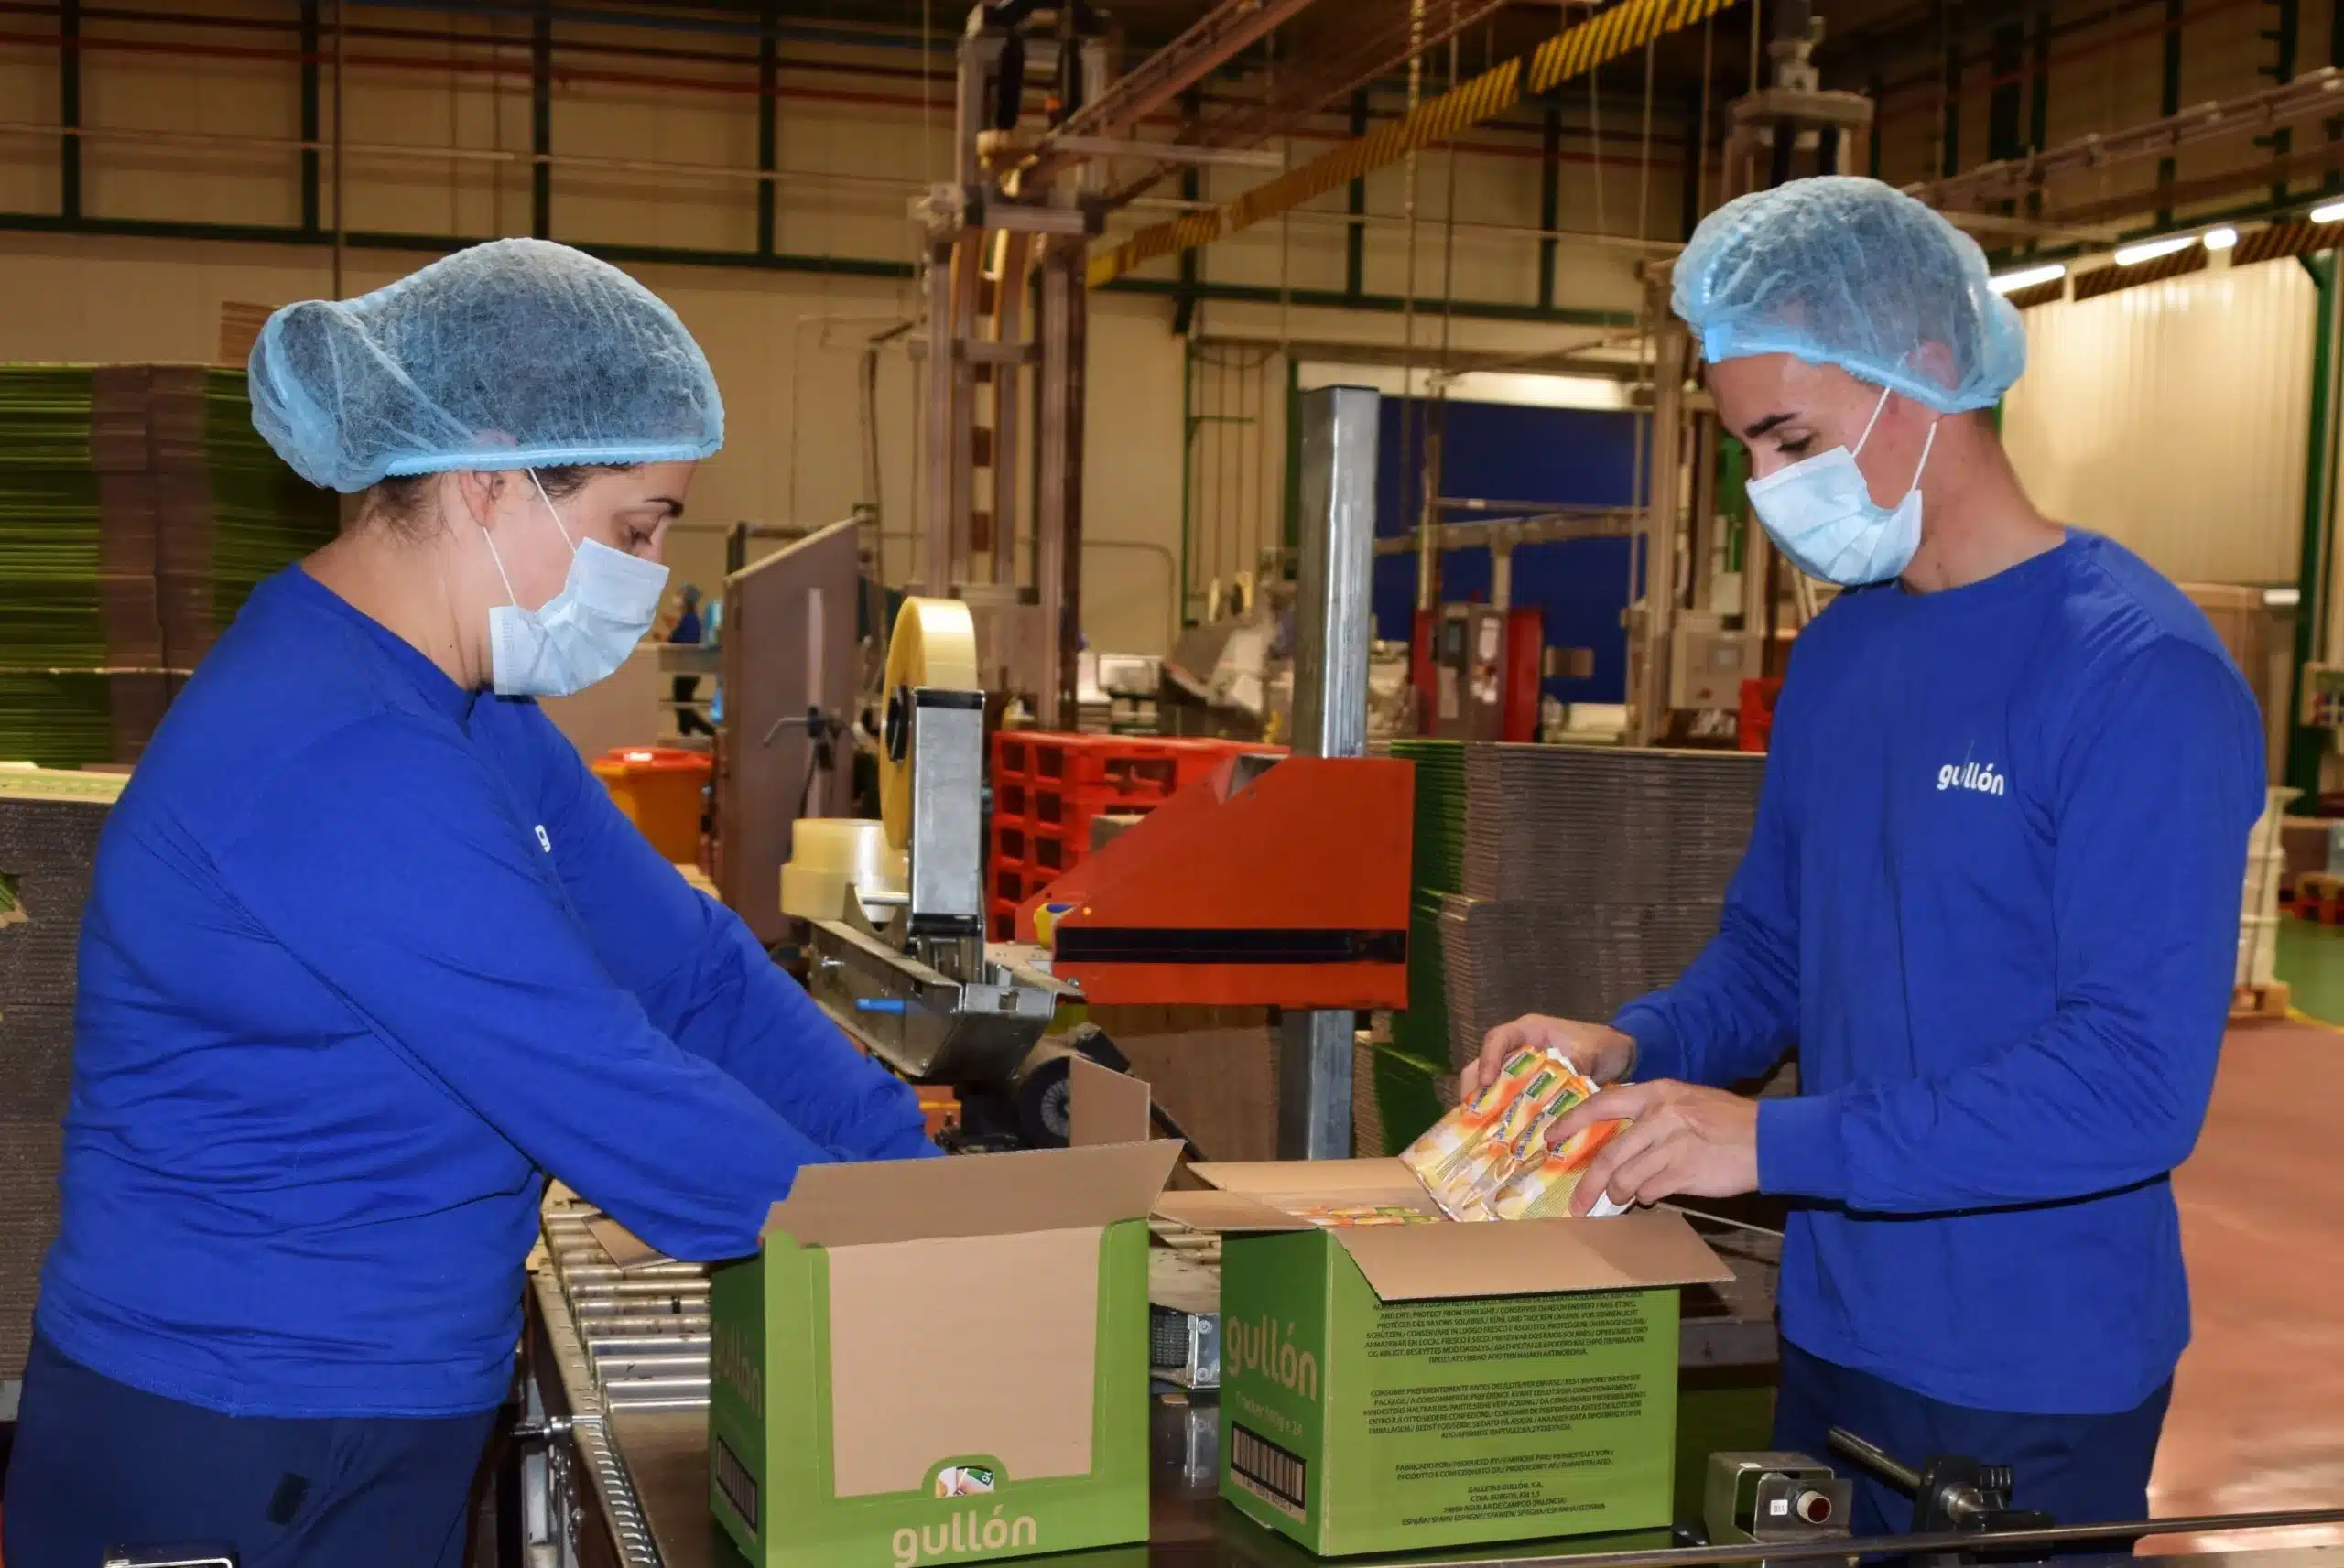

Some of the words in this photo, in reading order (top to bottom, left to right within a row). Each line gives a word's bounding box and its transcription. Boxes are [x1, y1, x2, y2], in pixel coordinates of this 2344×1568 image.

[1937, 762, 2004, 795] gullón
[1426, 1318, 1452, 1326] RAYONS
[1483, 1325, 1507, 1333] FRESCO
[1418, 1337, 1439, 1346] LOCAL
[1227, 1314, 1317, 1401] gullón
[1416, 1394, 1460, 1403] CONSOMMER
[1368, 1417, 1391, 1425] ENTRO
[1395, 1462, 1433, 1471] FABRICADO
[1397, 1471, 1433, 1480] PRODOTTO
[1439, 1466, 1490, 1476] CONFEZIONATO
[1468, 1484, 1500, 1493] GALLETAS
[1463, 1502, 1492, 1511] AGUILAR
[1492, 1501, 1503, 1509] DE
[1503, 1499, 1531, 1509] CAMPOO
[892, 1503, 1036, 1568] gullón
